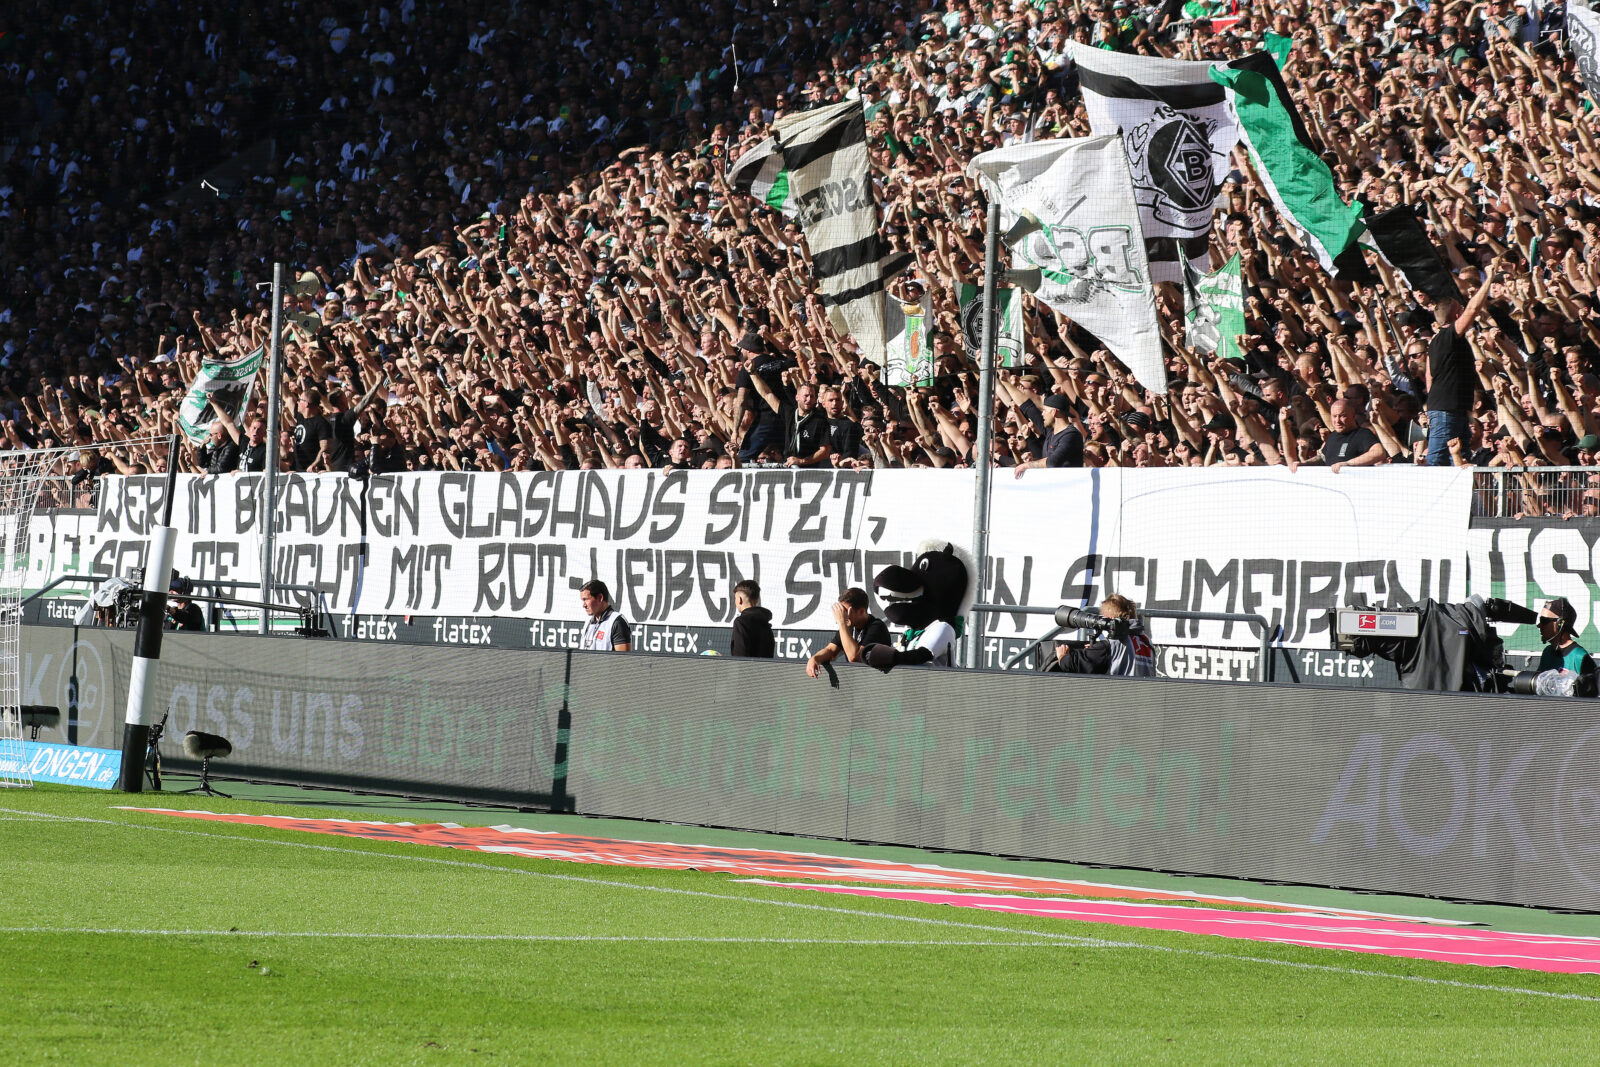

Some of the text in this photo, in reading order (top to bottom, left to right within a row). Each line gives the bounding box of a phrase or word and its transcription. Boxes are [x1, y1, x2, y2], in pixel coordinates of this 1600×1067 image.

[187, 474, 219, 534] IM
[438, 470, 689, 543] GLASHAUS
[705, 470, 887, 545] SITZT,
[385, 544, 452, 610] MIT
[433, 616, 492, 645] flatex
[632, 623, 698, 654] flatex
[1164, 645, 1259, 682] GEHT
[1301, 651, 1375, 679] flatex
[168, 670, 1235, 837] ass uns über Gesundheit reden!
[1310, 731, 1543, 863] AOK
